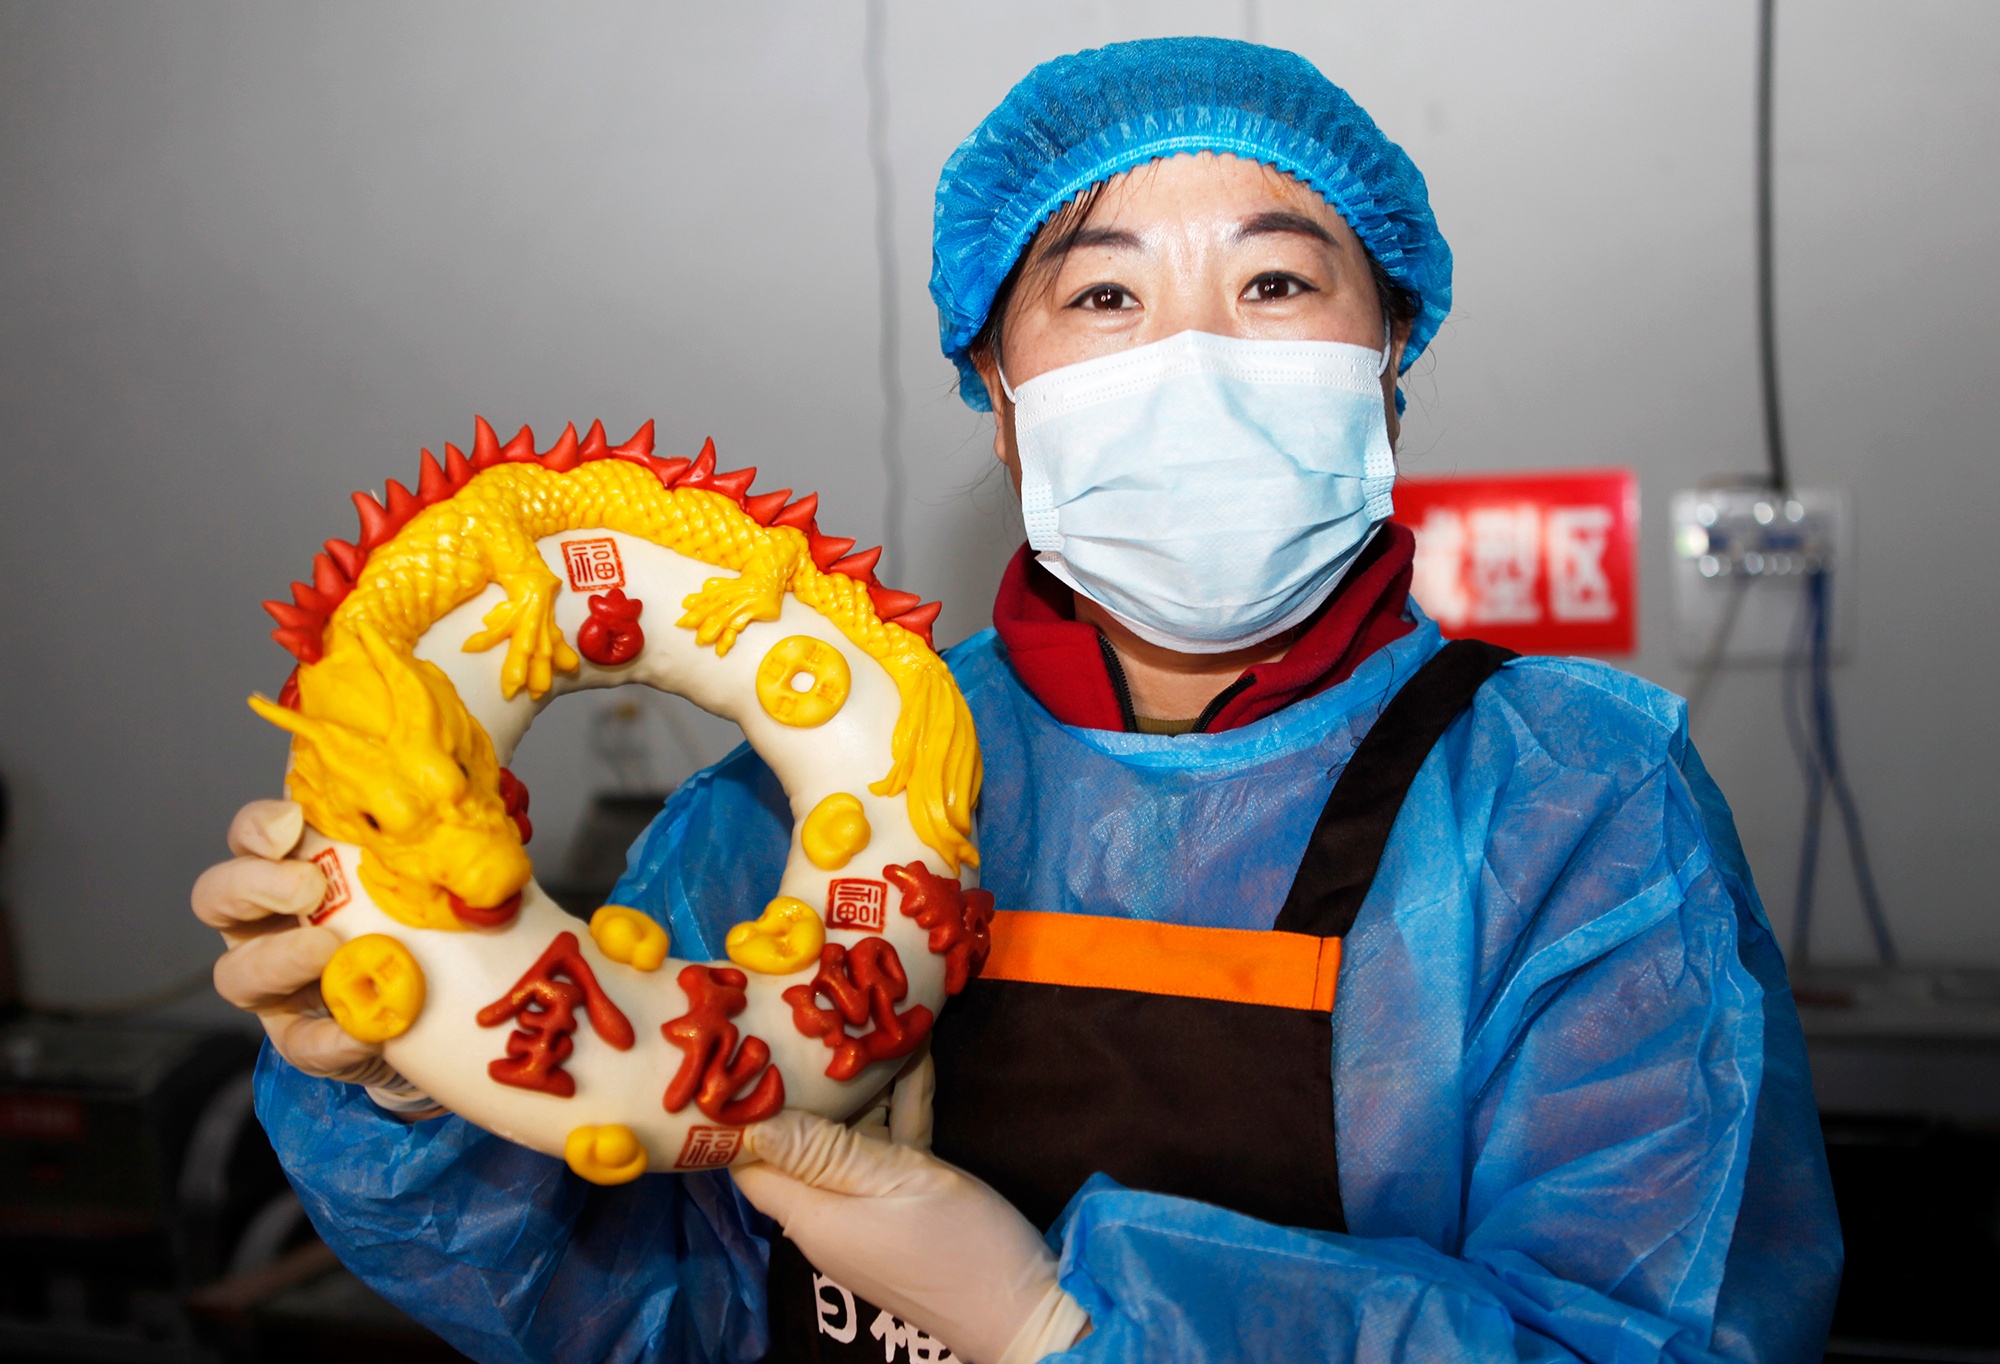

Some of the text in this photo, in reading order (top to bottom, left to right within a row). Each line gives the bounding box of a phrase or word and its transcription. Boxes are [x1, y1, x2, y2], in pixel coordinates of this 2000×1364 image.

[569, 542, 618, 585] 福
[835, 883, 881, 927] 福
[681, 1130, 739, 1167] 福
